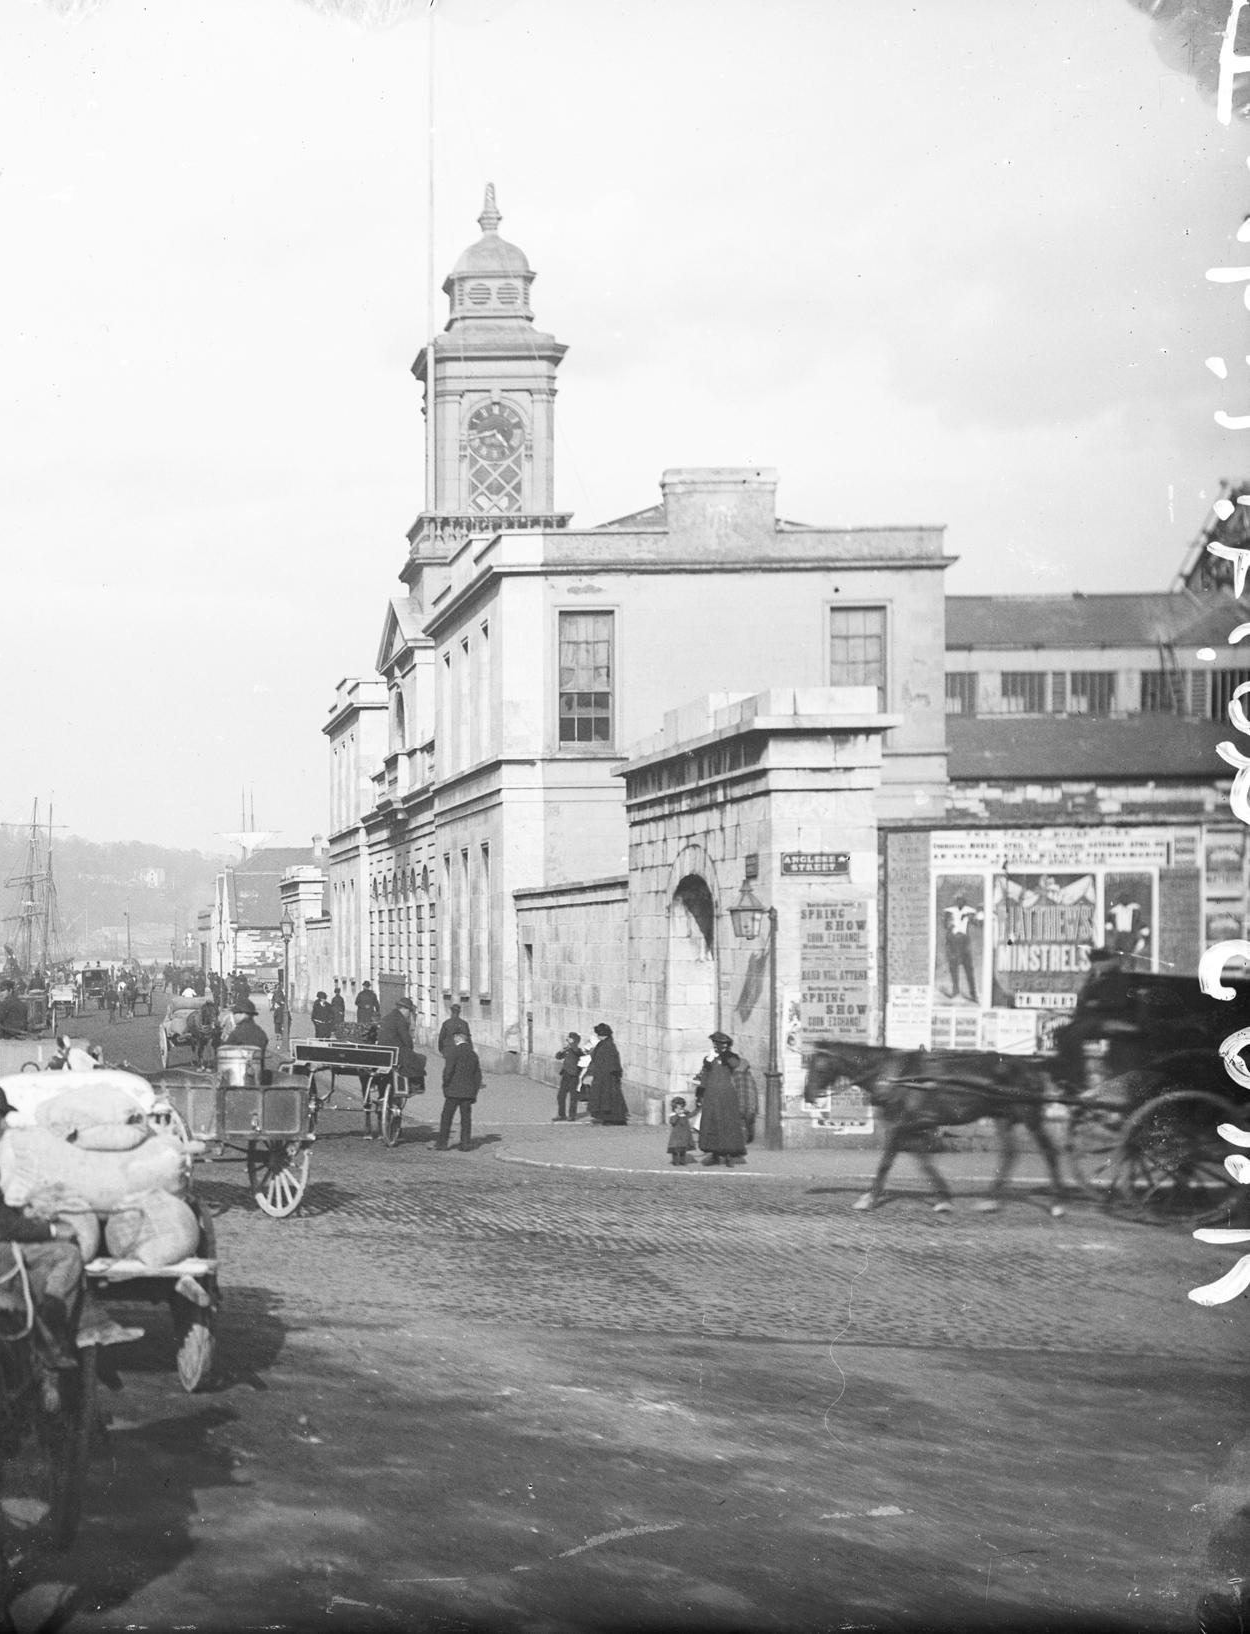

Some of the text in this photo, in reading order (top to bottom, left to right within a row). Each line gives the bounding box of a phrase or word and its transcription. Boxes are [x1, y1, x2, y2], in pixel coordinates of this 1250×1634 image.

[790, 863, 836, 872] STREET
[800, 908, 846, 920] SPRING
[825, 920, 867, 931] SHOW
[996, 944, 1092, 972] MINSTRELS
[801, 992, 847, 1004] SPRING
[826, 1004, 868, 1015] SHOW
